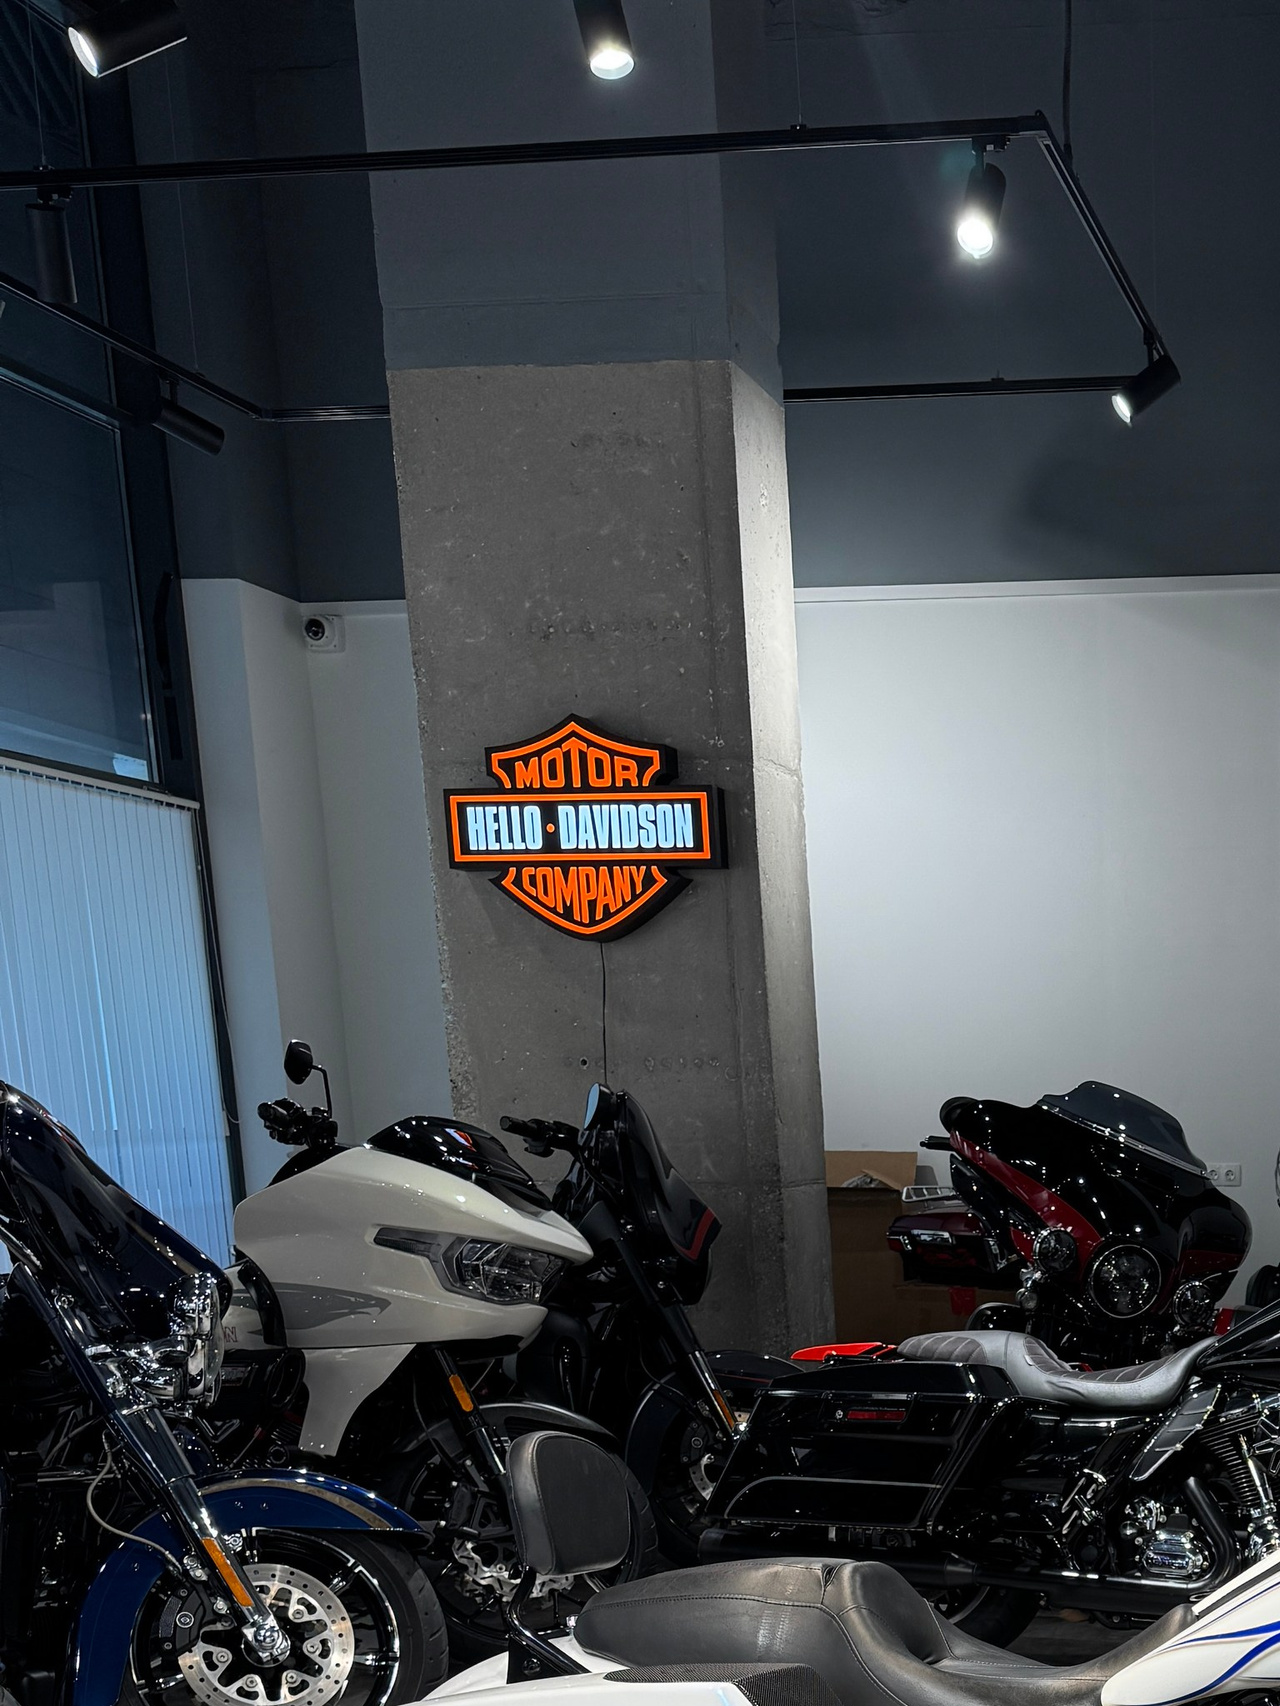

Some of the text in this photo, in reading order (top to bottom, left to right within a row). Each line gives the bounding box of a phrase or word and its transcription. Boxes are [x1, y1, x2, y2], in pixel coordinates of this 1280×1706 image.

[515, 737, 639, 788] MOTOR
[466, 803, 694, 851] HELLO DAVIDSON
[522, 866, 646, 923] COMPANY
